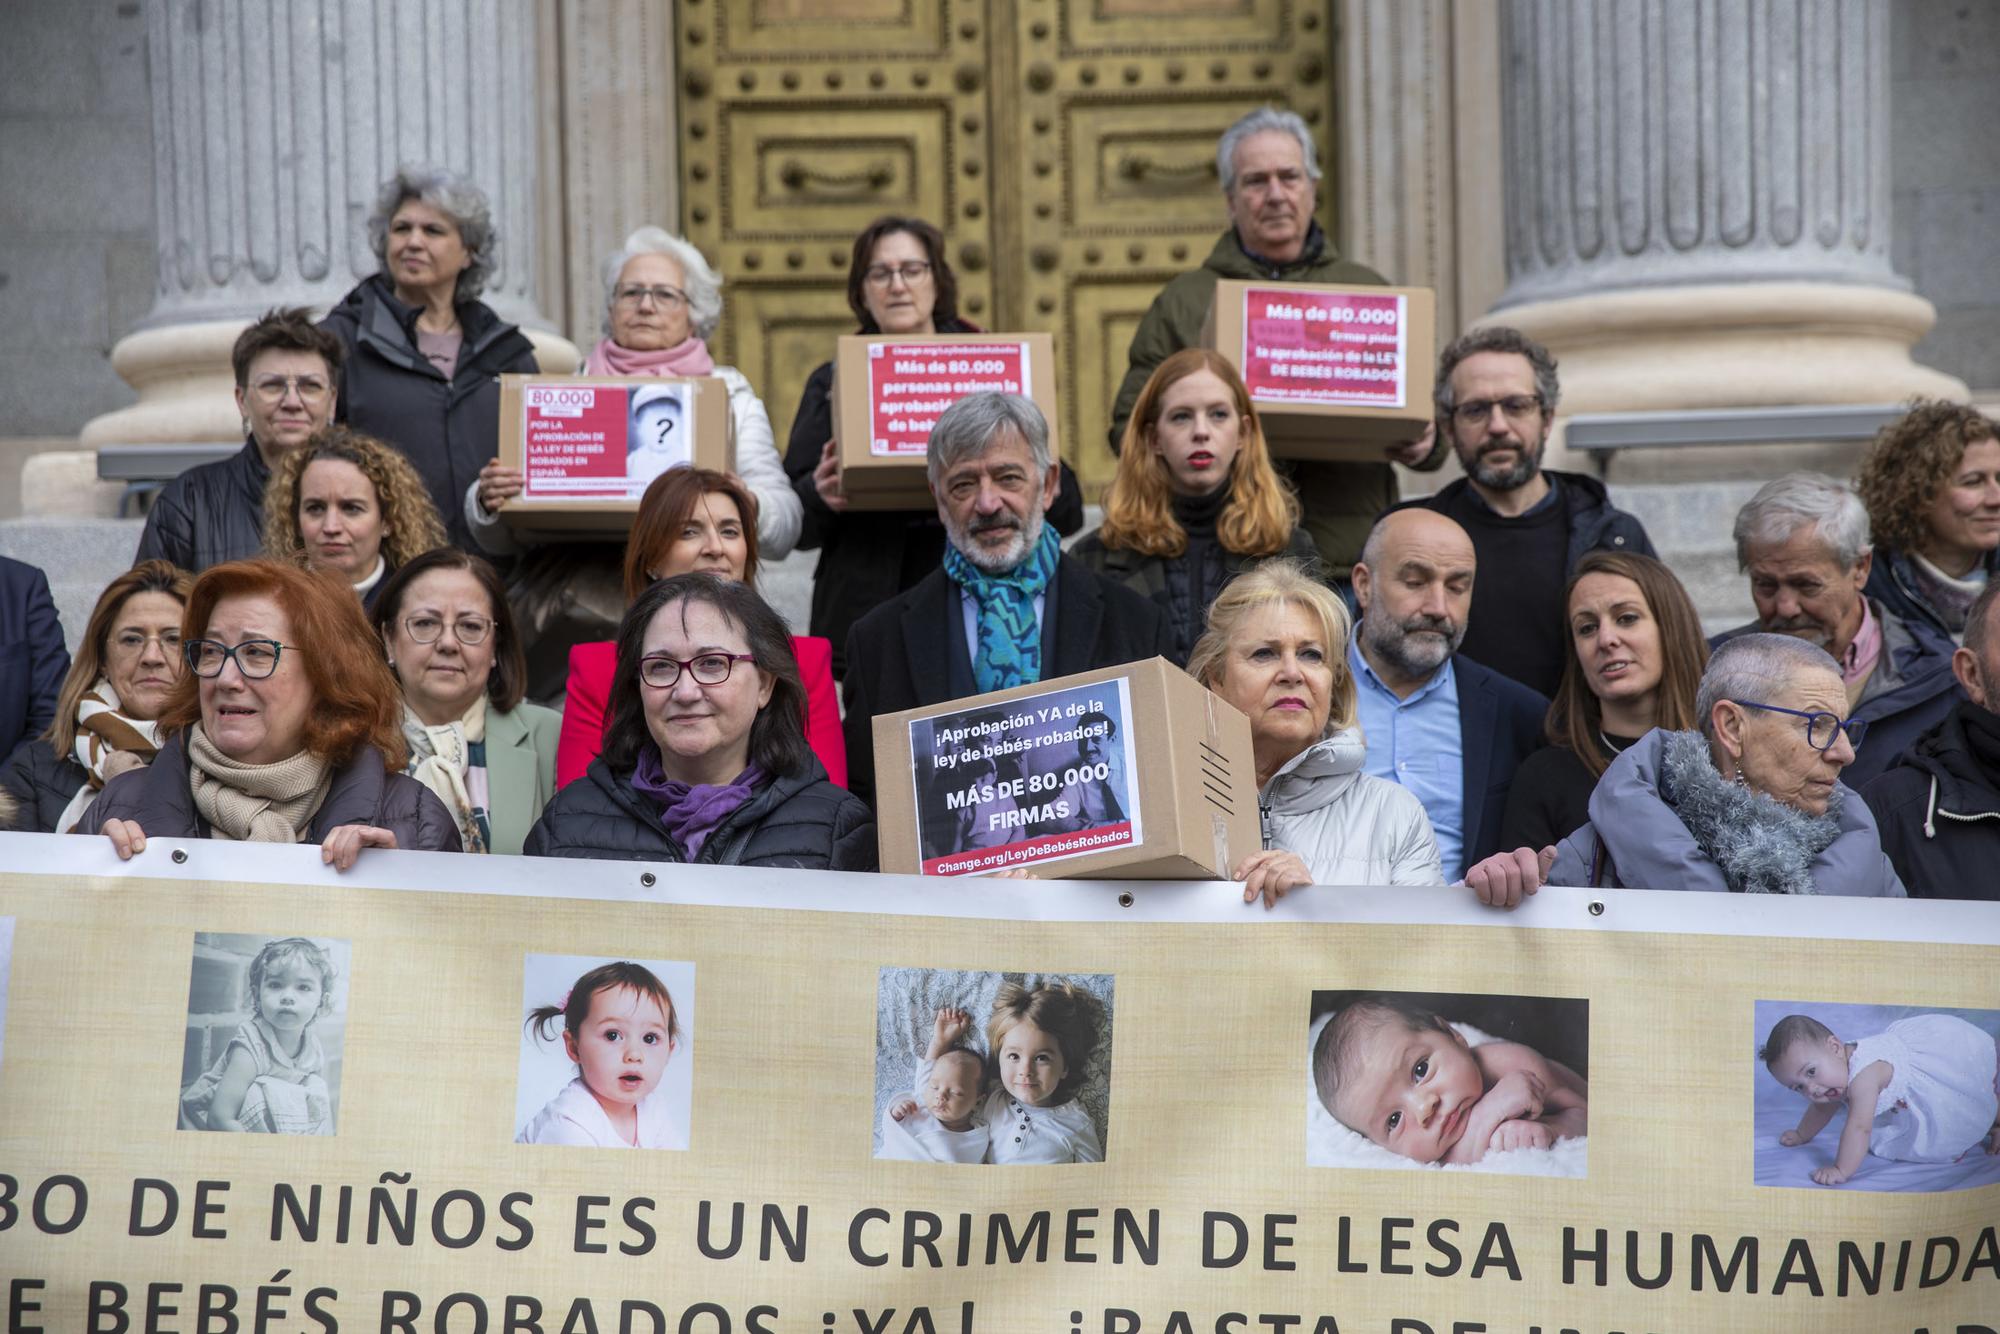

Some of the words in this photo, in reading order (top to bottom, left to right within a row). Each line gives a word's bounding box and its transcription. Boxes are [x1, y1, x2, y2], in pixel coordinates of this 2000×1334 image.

[1266, 304, 1303, 320] Más
[1305, 306, 1328, 322] de
[1329, 307, 1396, 324] 80.000
[1270, 348, 1343, 362] aprobación
[1345, 350, 1361, 363] de
[1363, 350, 1376, 363] la
[894, 361, 926, 374] Más
[928, 361, 946, 374] de
[948, 360, 1005, 374] 80.000
[1270, 364, 1289, 376] DE
[1290, 365, 1332, 379] BEBÉS
[883, 382, 952, 397] personas
[1004, 379, 1018, 392] la
[532, 390, 592, 405] 80.000
[530, 421, 549, 430] POR
[551, 421, 563, 430] LA
[887, 418, 907, 432] de
[533, 430, 591, 441] APROBACIÓN
[592, 432, 605, 441] DE
[530, 444, 542, 453] LA
[544, 444, 562, 453] LEY
[563, 444, 575, 453] DE
[576, 442, 605, 454] BEBÉS
[530, 456, 573, 465] ROBADOS
[575, 456, 588, 465] EN
[530, 467, 567, 477] ESPAÑA
[936, 713, 1034, 747] ¡Aprobación
[1037, 706, 1062, 722] YA
[1066, 703, 1086, 717] de
[1089, 699, 1103, 713] la
[933, 754, 957, 769] ley
[961, 747, 981, 763] de
[984, 737, 1033, 759] bebés
[1036, 720, 1109, 748] robados!
[946, 784, 995, 810] MÁS
[997, 778, 1025, 800] DE
[1028, 762, 1109, 793] 80.000
[989, 801, 1070, 831] FIRMAS
[937, 830, 1130, 874] Change.org/LeyDeBebésRobados
[128, 1177, 231, 1239] DE
[269, 1171, 534, 1251] NIÑOS
[574, 1195, 657, 1256] ES
[696, 1200, 809, 1262] UN
[847, 1207, 1160, 1268] CRIMEN
[1201, 1211, 1298, 1271] DE
[1337, 1215, 1523, 1281] LESA
[87, 1268, 340, 1334] BEBÉS
